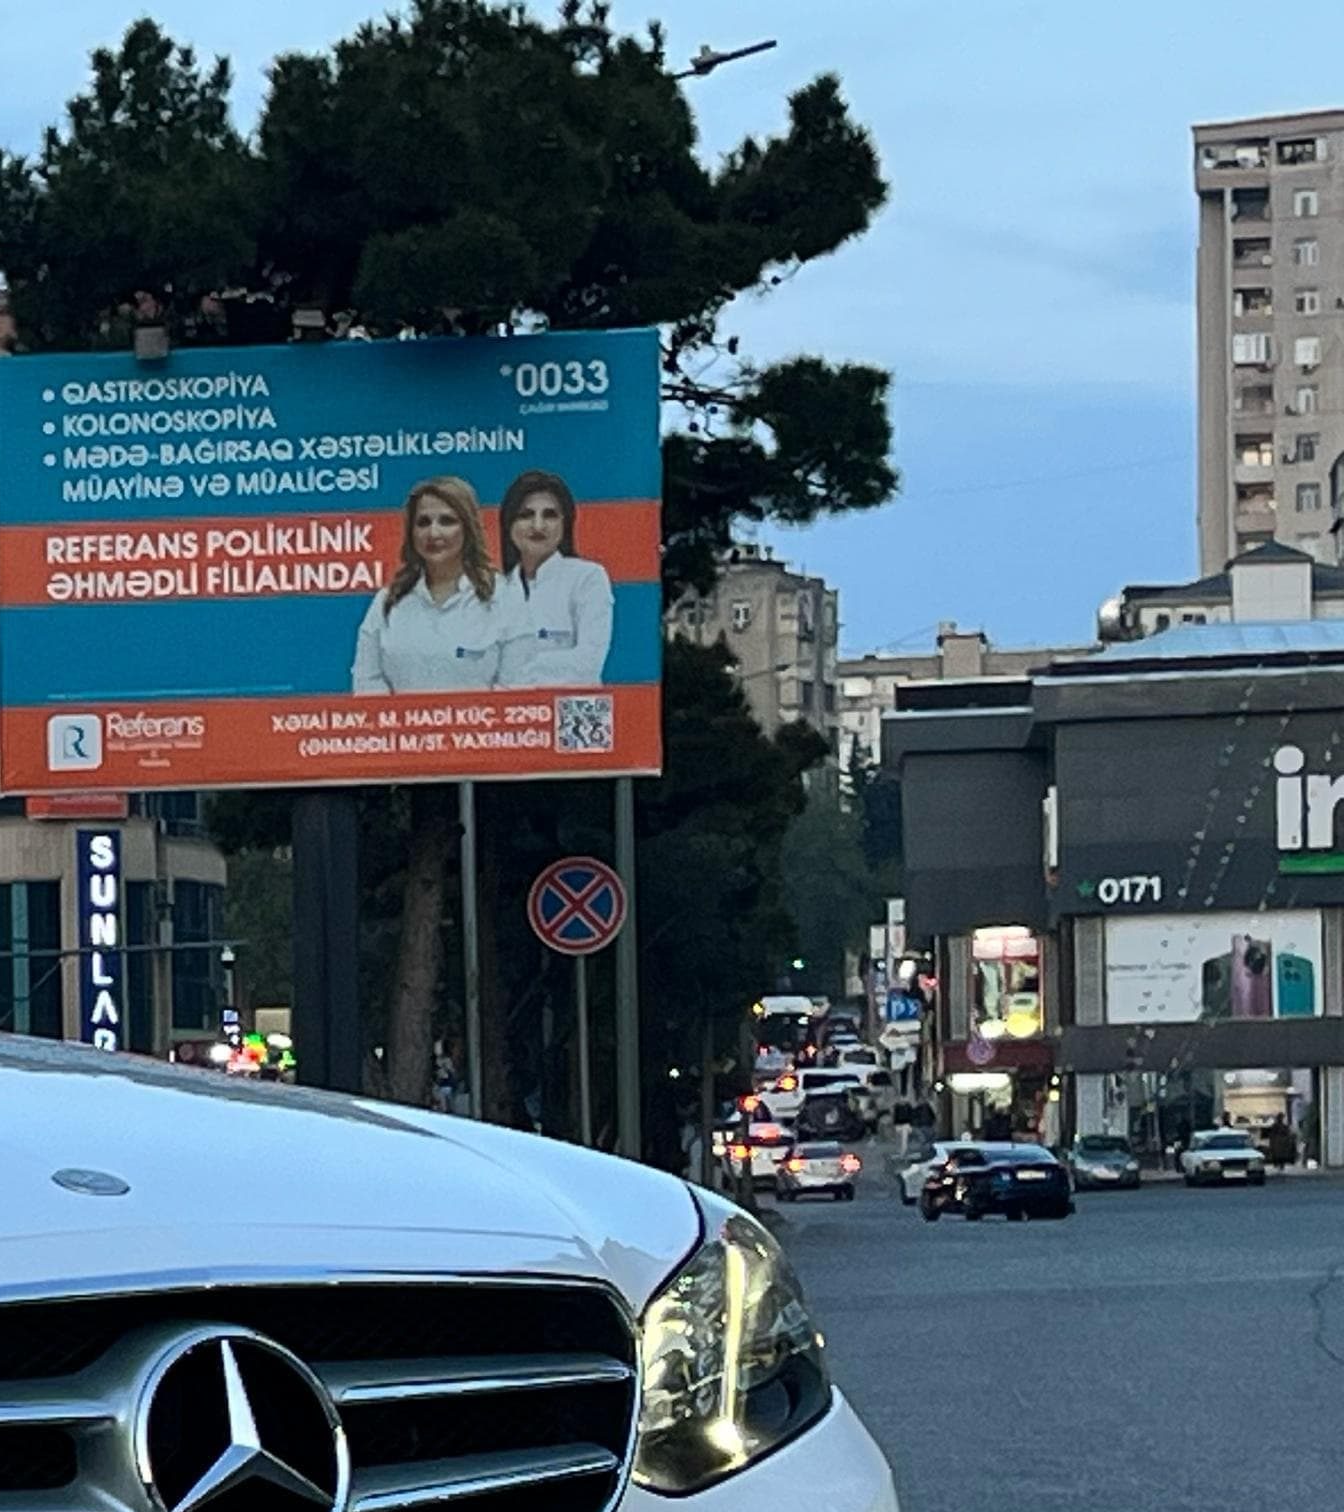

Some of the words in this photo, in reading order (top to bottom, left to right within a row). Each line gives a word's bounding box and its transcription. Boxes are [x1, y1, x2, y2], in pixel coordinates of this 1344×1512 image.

[61, 371, 270, 405] QASTROSKOPİYA
[62, 403, 277, 437] KOLONOSKOPİYA
[63, 438, 294, 469] MƏDƏ-BAĞIRSAQ
[298, 424, 525, 460] XƏSTƏLİKLƏRİNİN
[62, 472, 185, 502] MÜAYİNƏ
[189, 473, 231, 497] VƏ
[236, 463, 380, 496] MÜALİCƏSİ
[46, 531, 198, 564] REFERANS
[206, 519, 373, 558] POLİKLİNİK
[46, 562, 198, 601] ƏHMƏDLİ
[105, 711, 205, 739] Referans
